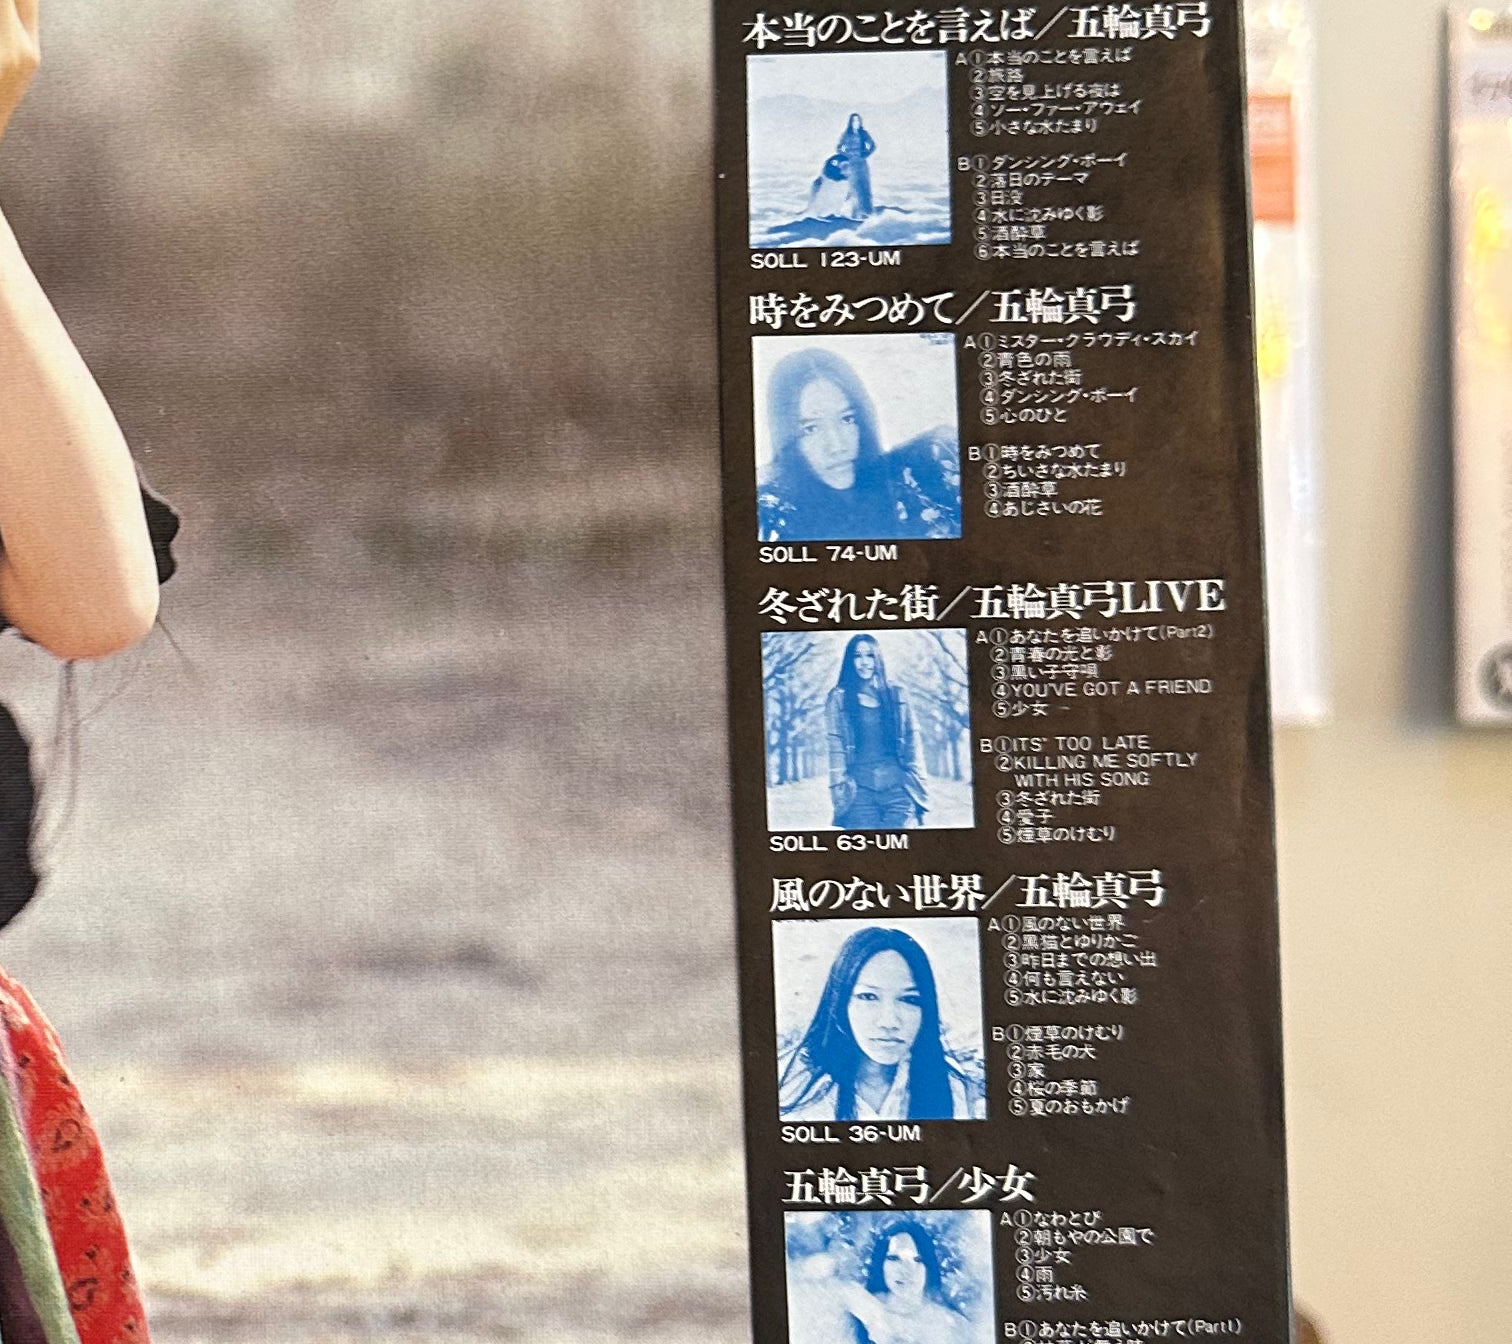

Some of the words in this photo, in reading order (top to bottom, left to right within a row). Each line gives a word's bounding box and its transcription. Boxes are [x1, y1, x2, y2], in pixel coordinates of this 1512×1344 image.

[750, 252, 808, 269] SOLL
[821, 250, 901, 268] 123-UM
[758, 546, 818, 563] SOLL
[825, 544, 898, 562] 74-UM
[1083, 681, 1120, 695] GOT
[1127, 681, 1139, 695] A
[1145, 679, 1213, 694] FRIEND
[1093, 754, 1120, 768] ME
[1127, 753, 1198, 767] SOFTLY
[1015, 774, 1058, 787] WITH
[1065, 773, 1093, 786] HIS
[1101, 772, 1151, 786] SONG
[769, 835, 829, 852] SOLL
[836, 833, 909, 851] 63-UM
[781, 1125, 840, 1143] SOLL
[848, 1124, 921, 1143] 36-UM
